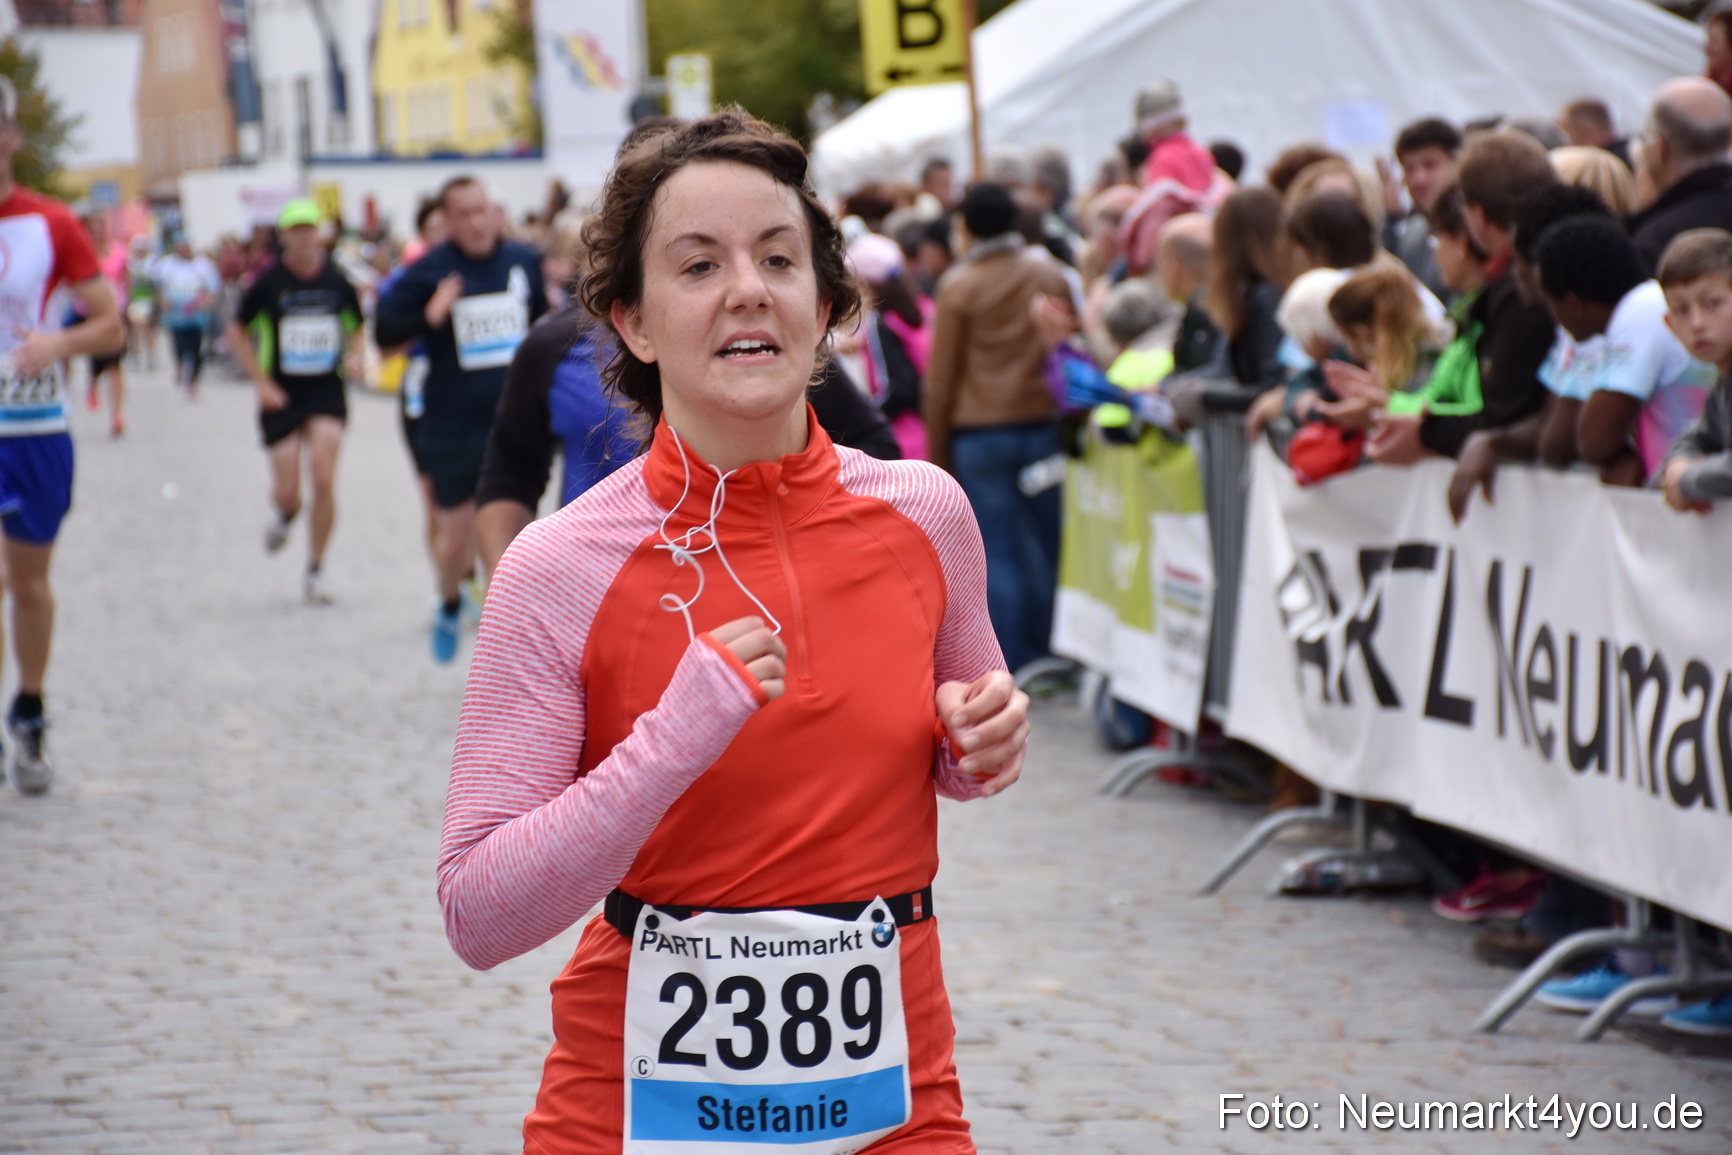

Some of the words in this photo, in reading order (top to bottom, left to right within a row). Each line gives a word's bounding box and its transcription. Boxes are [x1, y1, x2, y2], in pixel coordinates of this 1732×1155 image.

[894, 0, 946, 50] B
[639, 929, 722, 960] PARTL
[731, 929, 862, 959] Neumarkt
[658, 965, 882, 1070] 2389
[697, 1094, 848, 1133] Stefanie
